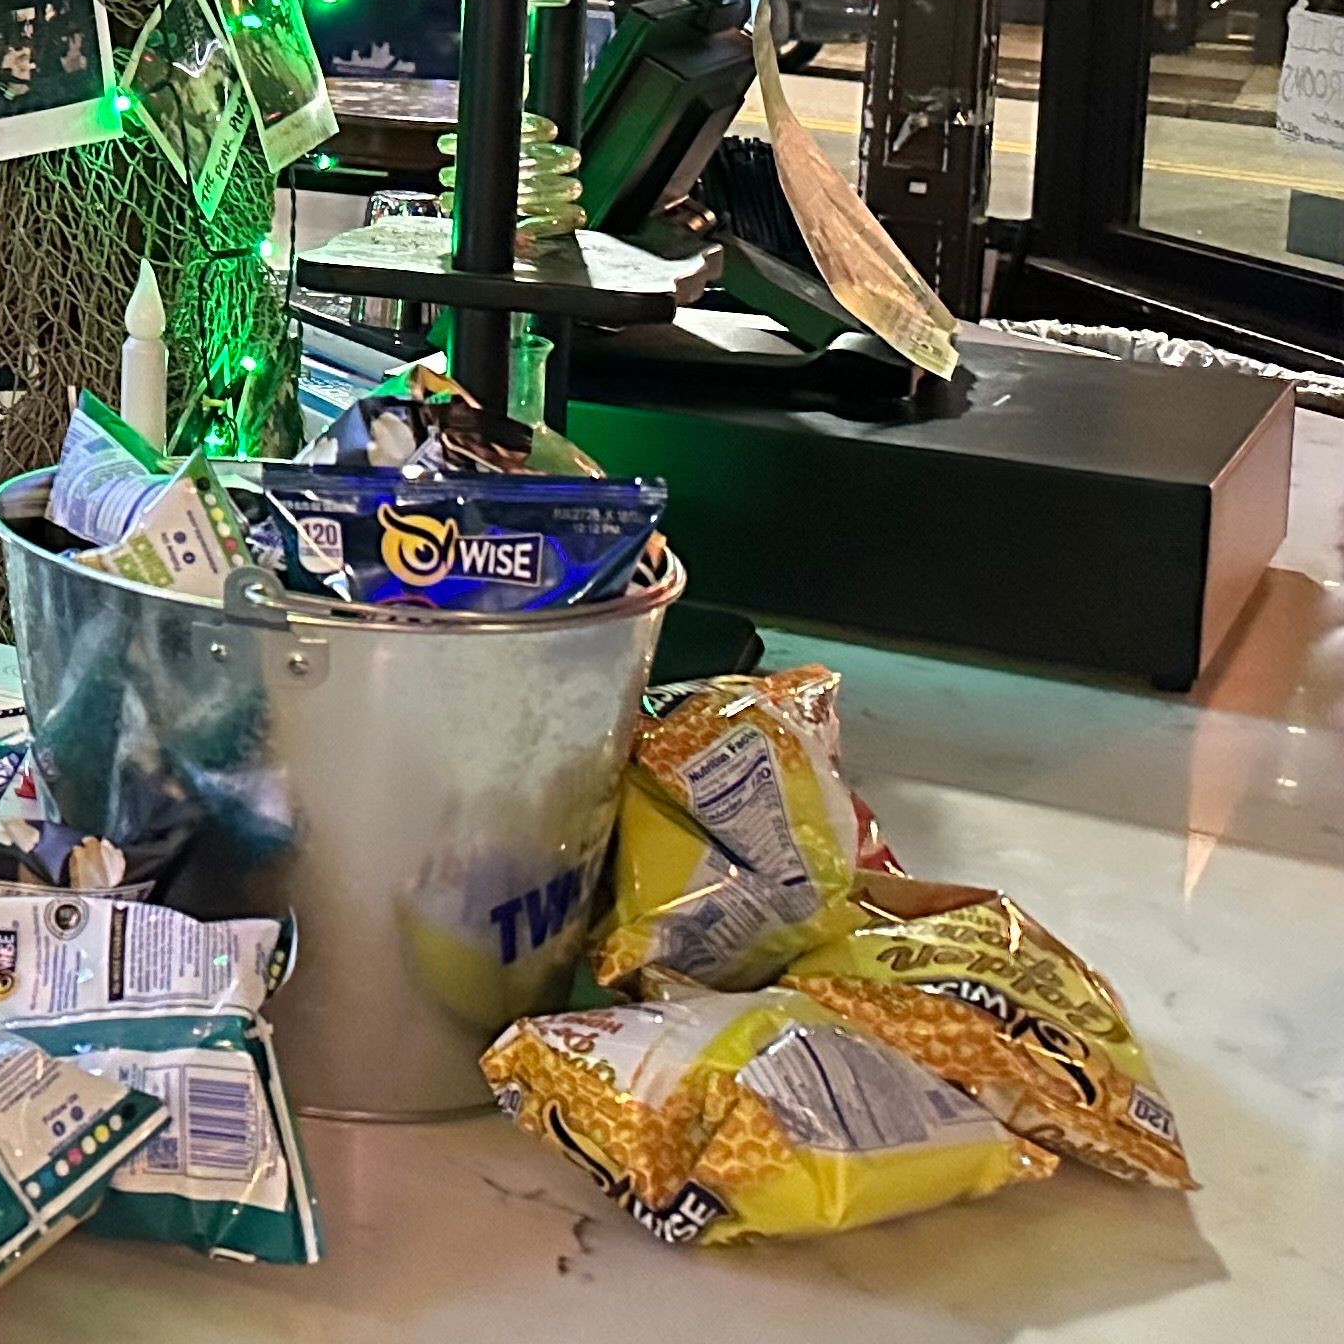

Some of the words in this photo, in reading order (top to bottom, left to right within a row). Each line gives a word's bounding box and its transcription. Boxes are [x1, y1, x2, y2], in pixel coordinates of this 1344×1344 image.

[459, 539, 533, 578] WISE
[688, 752, 731, 784] Nutrition
[1135, 1100, 1171, 1134] 120
